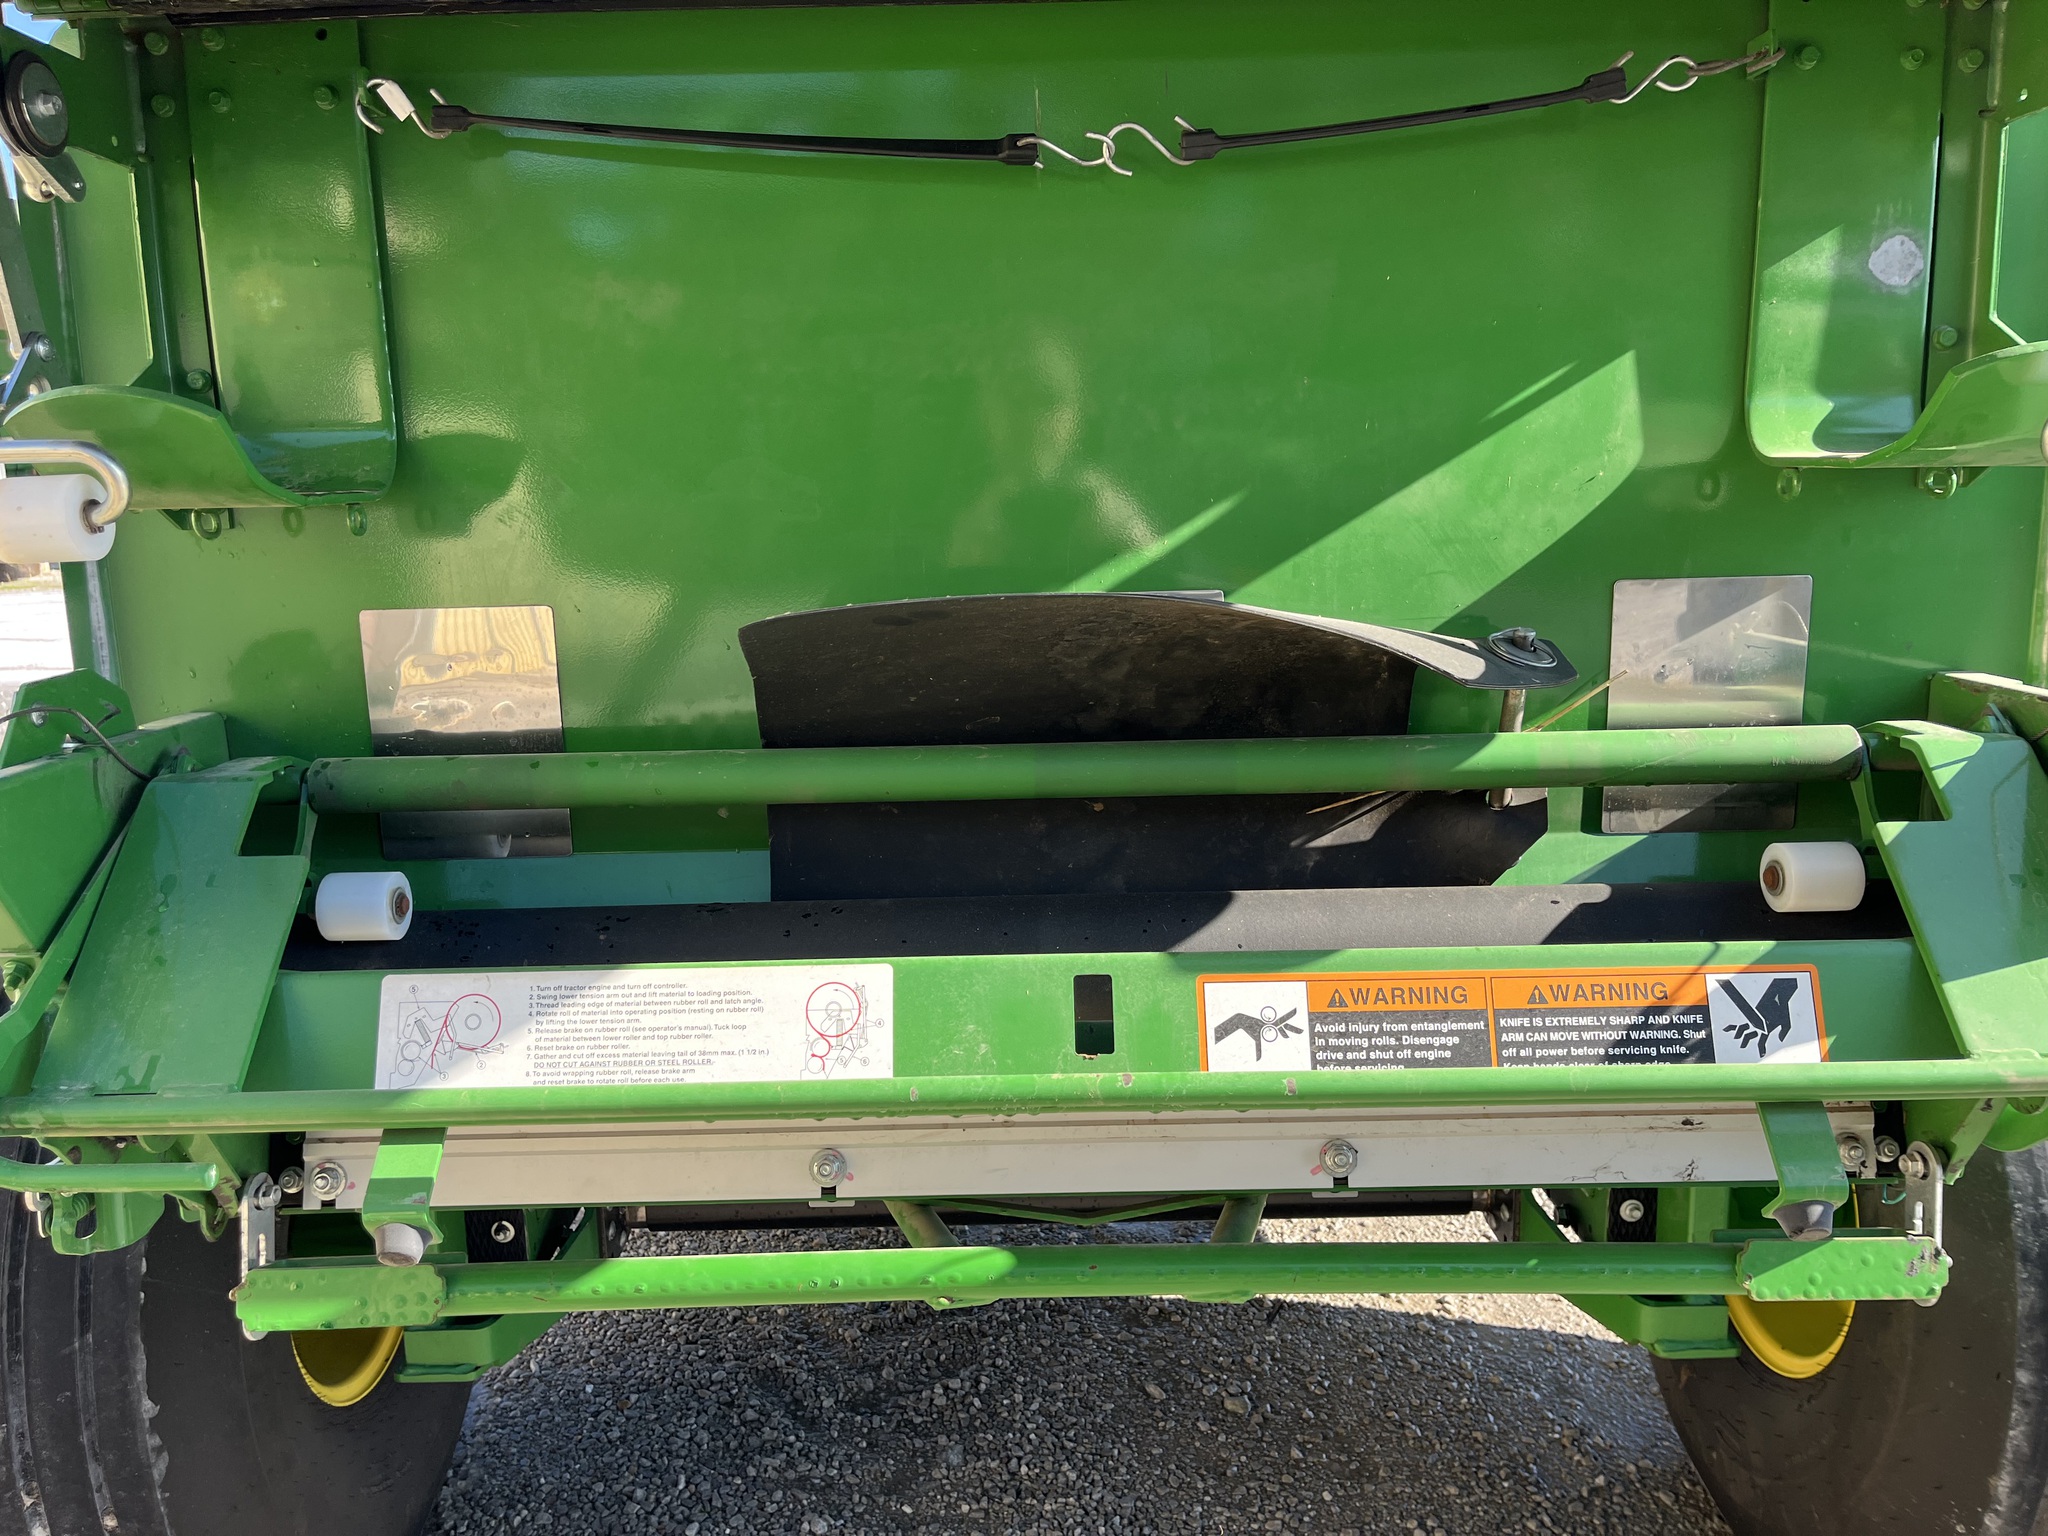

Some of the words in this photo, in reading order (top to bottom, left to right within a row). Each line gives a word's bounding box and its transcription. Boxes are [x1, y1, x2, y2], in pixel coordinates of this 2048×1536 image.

[588, 984, 611, 992] engine
[1549, 982, 1668, 1001] WARNING
[536, 993, 558, 1001] Swing
[696, 990, 721, 998] loading
[723, 990, 753, 998] position.
[1350, 986, 1468, 1005] WARNING
[561, 1001, 585, 1009] leading
[587, 1001, 604, 1009] edge
[743, 998, 764, 1006] angle.
[625, 1008, 657, 1016] operating
[659, 1008, 686, 1016] position
[536, 1019, 544, 1027] by
[1500, 1018, 1530, 1027] KNIFE
[1533, 1018, 1543, 1026] IS
[1546, 1016, 1606, 1026] EXTREMELY
[1609, 1016, 1645, 1025] SHARP
[1648, 1015, 1670, 1024] AND
[1673, 1015, 1703, 1024] KNIFE
[1315, 1023, 1345, 1032] Avoid
[1349, 1022, 1379, 1033] injury
[1382, 1022, 1408, 1031] from
[1411, 1021, 1484, 1031] entanglement
[1329, 1036, 1368, 1047] moving
[1372, 1036, 1399, 1044] rolls.
[1403, 1036, 1459, 1046] Disengage
[1502, 1032, 1524, 1042] ARM
[1527, 1032, 1547, 1041] CAN
[1550, 1032, 1579, 1041] MOVE
[1581, 1031, 1627, 1040] WITHOUT
[1630, 1030, 1681, 1039] WARNING.
[1683, 1030, 1706, 1039] Shut
[651, 1051, 675, 1059] leaving
[1316, 1051, 1343, 1059] drive
[1347, 1050, 1366, 1059] and
[1370, 1049, 1393, 1058] shut
[1397, 1049, 1412, 1058] off
[1415, 1049, 1451, 1059] engine
[1502, 1048, 1517, 1057] off
[1520, 1048, 1532, 1056] all
[1536, 1048, 1568, 1058] power
[1571, 1047, 1604, 1056] before
[1608, 1046, 1656, 1056] servicing
[1660, 1045, 1689, 1054] knife.
[562, 1069, 594, 1078] wrapping
